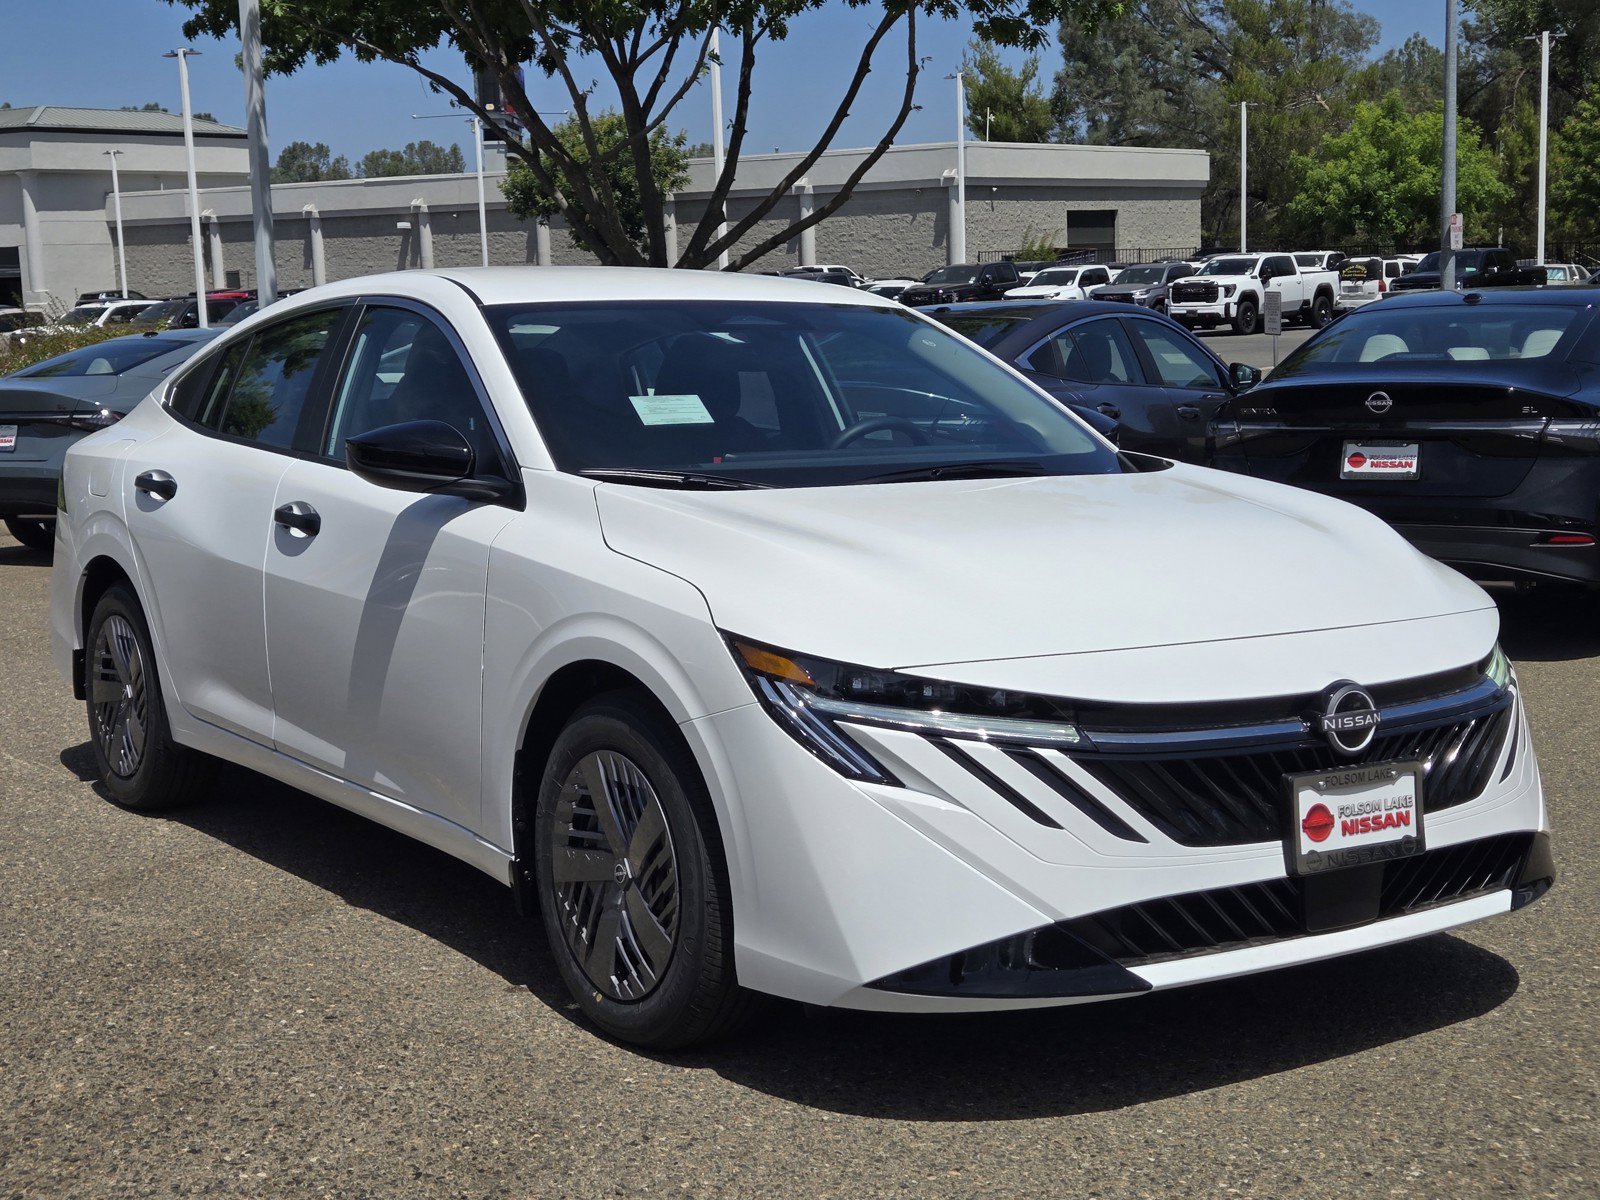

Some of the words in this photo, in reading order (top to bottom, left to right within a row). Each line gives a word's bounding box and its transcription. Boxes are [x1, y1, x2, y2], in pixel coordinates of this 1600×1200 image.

[1370, 461, 1413, 469] NISSAN
[1324, 711, 1381, 730] NISSAN
[1325, 772, 1366, 787] FOLSOM
[1368, 768, 1392, 782] LAKE
[1338, 801, 1382, 818] FOLSOM
[1384, 795, 1413, 811] LAKE
[1341, 810, 1411, 837] NISSAN
